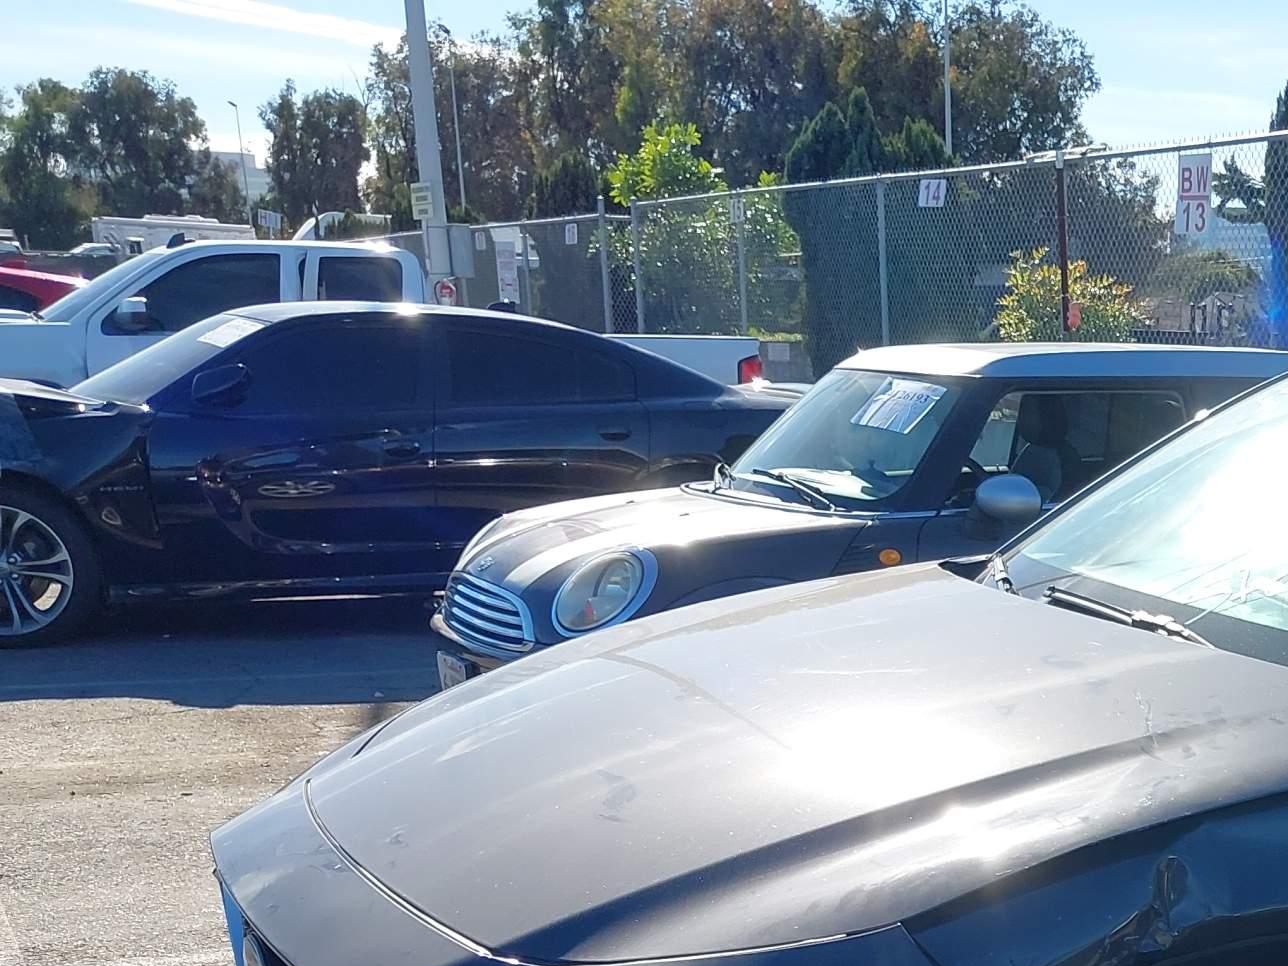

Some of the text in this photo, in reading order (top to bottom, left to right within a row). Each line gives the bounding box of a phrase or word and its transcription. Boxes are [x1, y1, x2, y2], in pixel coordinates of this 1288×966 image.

[924, 181, 942, 205] 14
[1181, 166, 1209, 194] BW
[1182, 202, 1206, 232] 13
